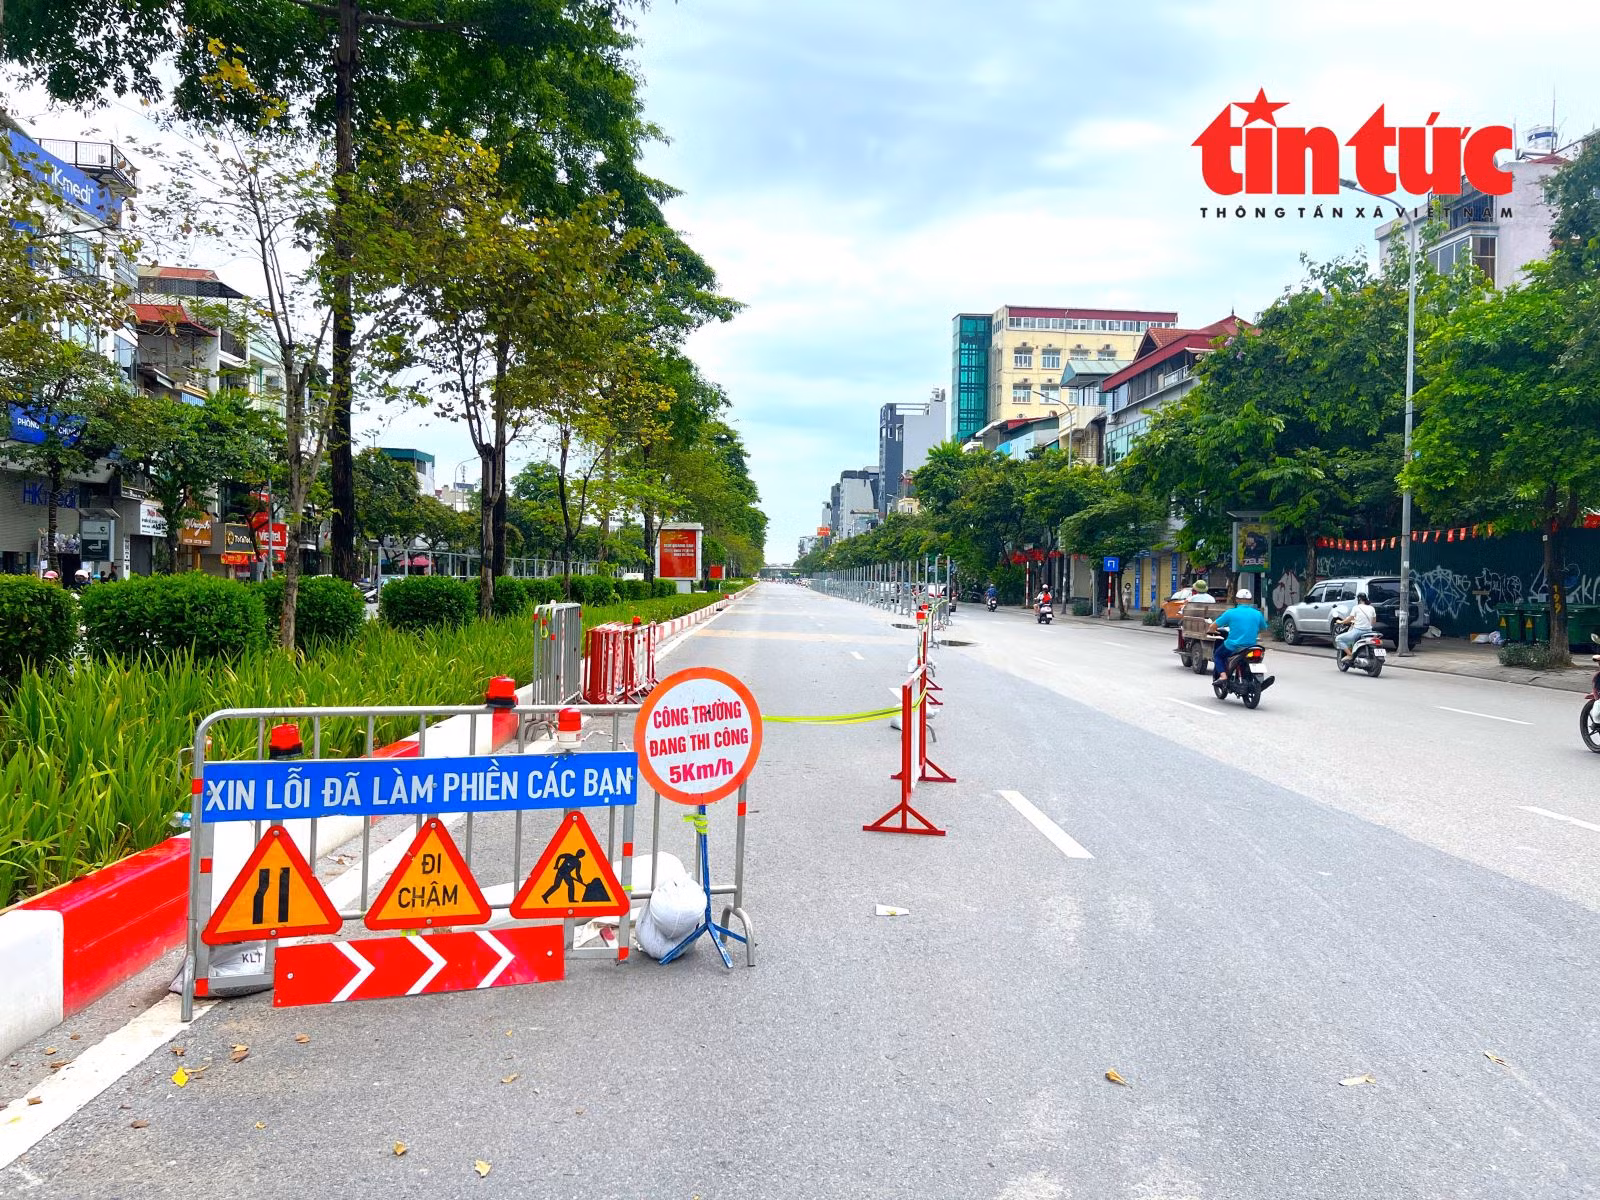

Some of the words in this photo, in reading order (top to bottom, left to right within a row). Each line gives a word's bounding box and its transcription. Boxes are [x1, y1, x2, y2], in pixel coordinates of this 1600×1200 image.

[258, 529, 282, 542] vietel
[653, 706, 689, 729] CÔNG
[691, 698, 742, 724] TRƯỜNG
[649, 736, 687, 757] ĐANG
[689, 733, 710, 751] THI
[713, 726, 749, 748] CÔNG
[205, 779, 256, 812] XIN
[265, 766, 311, 810] LỖI
[321, 771, 361, 808] ĐÃ
[372, 767, 434, 806] LÀM
[443, 758, 519, 803] PHIỀN
[527, 760, 576, 799] CÁC
[583, 766, 632, 804] BẠN
[669, 758, 734, 784] 5Km/h
[421, 852, 442, 875] ĐI
